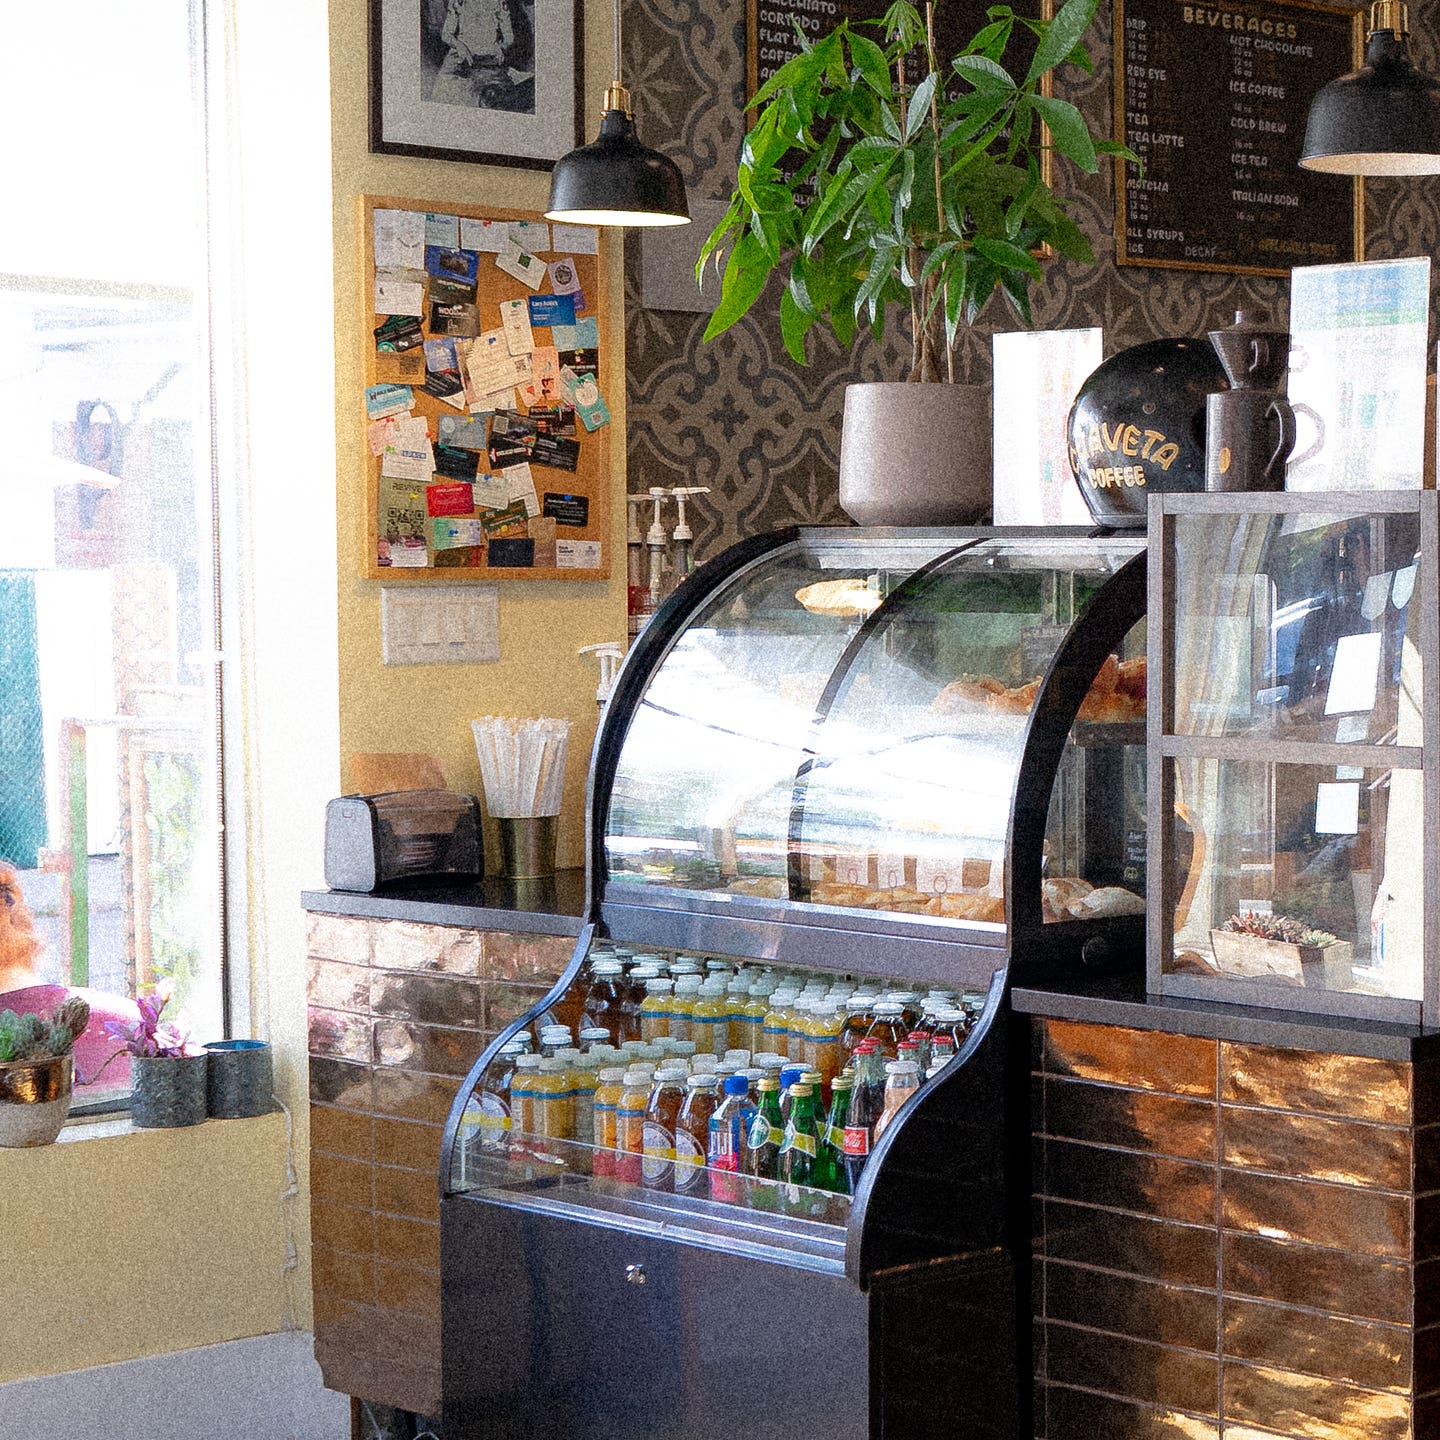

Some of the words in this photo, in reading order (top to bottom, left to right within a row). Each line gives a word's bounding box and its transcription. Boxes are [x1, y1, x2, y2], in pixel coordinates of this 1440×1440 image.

[1126, 18, 1147, 31] DRIP
[1183, 6, 1297, 39] BEVERAGES
[760, 28, 790, 45] FLAT
[1230, 35, 1252, 47] HOT
[1254, 38, 1313, 58] CHOCOLATE
[1149, 68, 1166, 81] EYE
[1230, 80, 1246, 93] ICE
[1247, 84, 1285, 99] COFFEE
[1128, 113, 1149, 125] TEA
[1230, 117, 1256, 130] COLD
[1258, 120, 1287, 133] BREW
[1128, 131, 1149, 143] TEA
[1152, 135, 1184, 148] LATTE
[1231, 153, 1247, 165] ICE
[1249, 154, 1268, 167] TEA
[1126, 179, 1169, 193] MATCHA
[1232, 190, 1273, 203] ITALIAN
[1273, 194, 1299, 207] SODA
[1126, 227, 1142, 238] ALL
[1147, 229, 1184, 242] SYRUPS
[1185, 246, 1217, 258] DECAF
[1088, 465, 1147, 489] COFFEE
[393, 483, 423, 492] REVIVE
